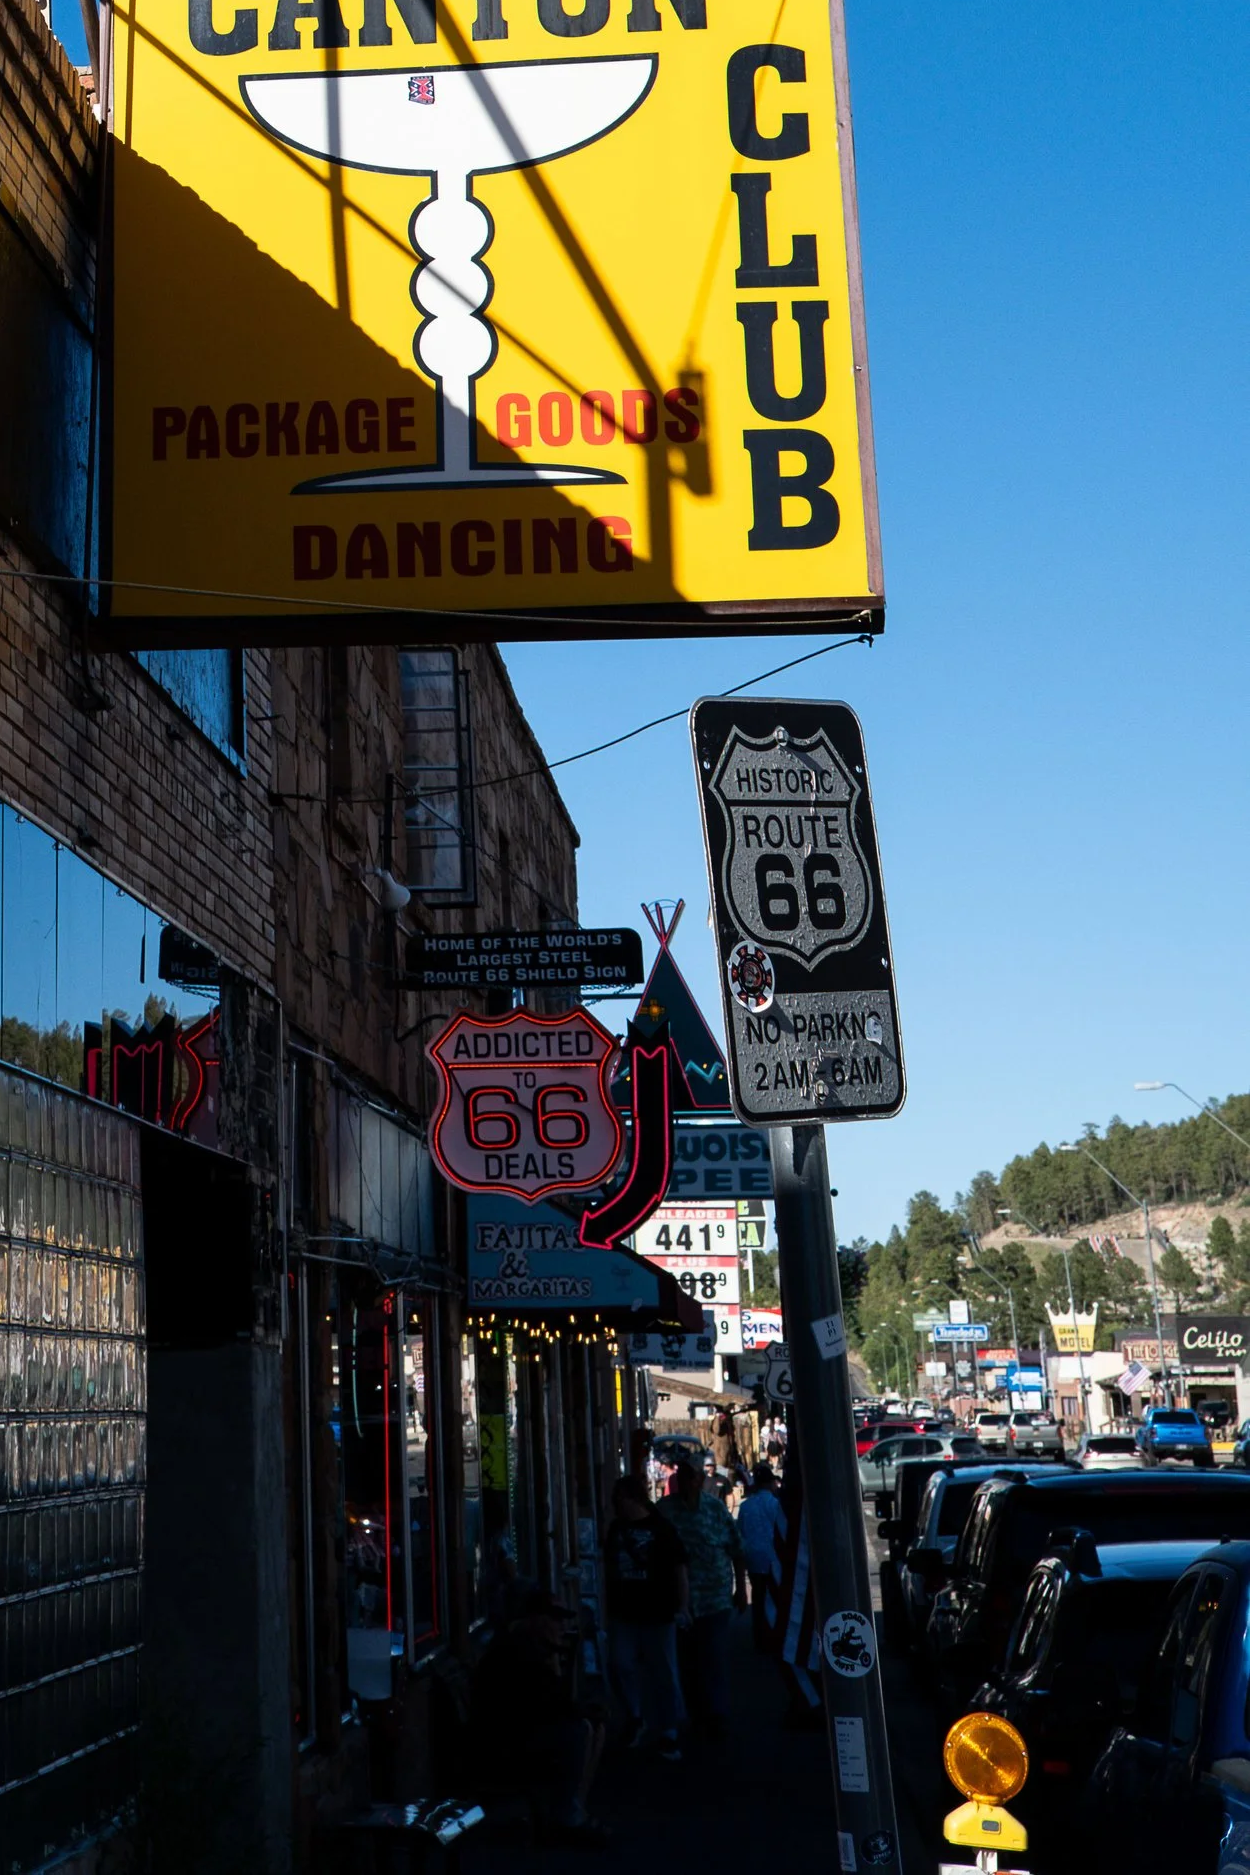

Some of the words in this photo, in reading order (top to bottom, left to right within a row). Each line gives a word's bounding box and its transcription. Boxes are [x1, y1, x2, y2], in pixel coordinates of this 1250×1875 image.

[726, 44, 840, 551] CLUB
[152, 395, 416, 461] PACKAGE
[496, 387, 701, 449] GOODS
[293, 516, 634, 581] DANCING
[737, 768, 834, 794] HISTORIC
[743, 814, 842, 848] ROUTE
[755, 853, 846, 931] 66
[423, 938, 475, 952] HOME
[481, 937, 503, 950] OF
[507, 936, 540, 949] THE
[456, 952, 533, 967] LARGEST
[538, 951, 592, 965] STEEL
[485, 968, 510, 982] 66
[515, 966, 579, 981] SHIELD
[583, 965, 627, 978] SIGN
[746, 1015, 781, 1044] NO
[793, 1011, 881, 1042] PARKN
[453, 1031, 594, 1059] ADDICTED
[512, 1072, 537, 1089] TO
[464, 1084, 590, 1151] 66
[485, 1152, 575, 1180] DEALS
[653, 1209, 728, 1219] NLEADED
[501, 1252, 528, 1279] &
[474, 1278, 592, 1298] MARGARITAS
[1182, 1326, 1243, 1349] Celilo
